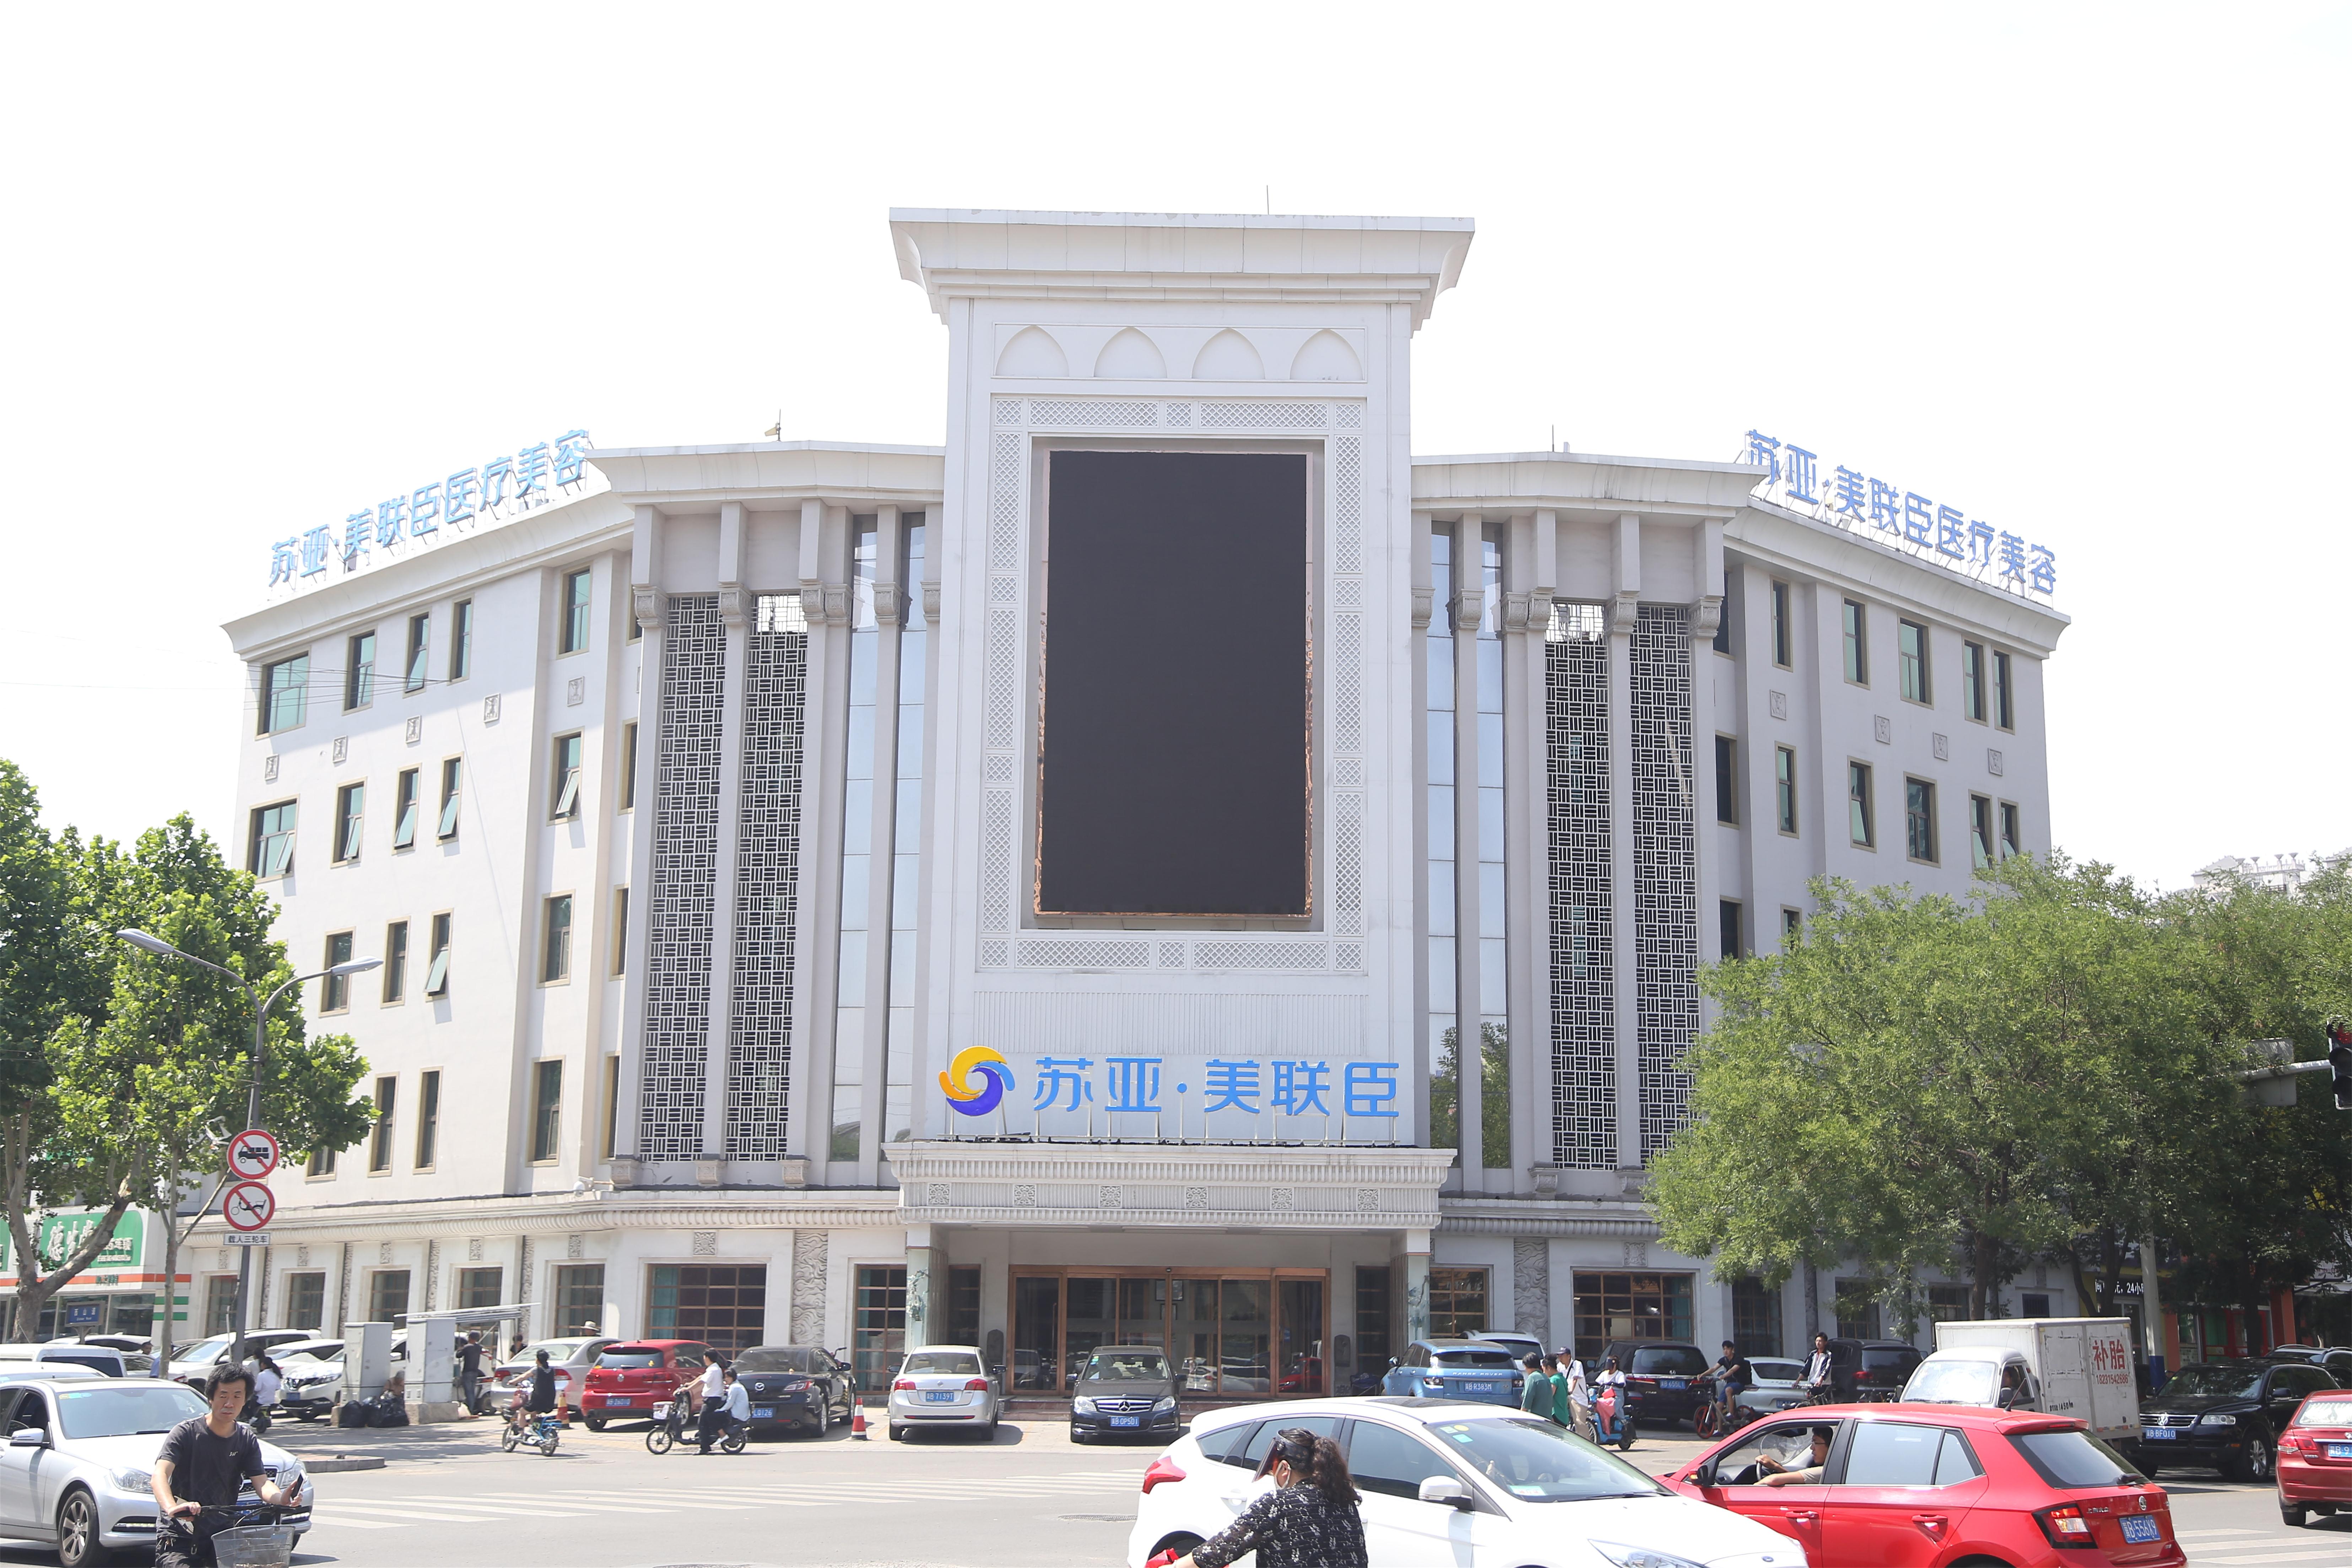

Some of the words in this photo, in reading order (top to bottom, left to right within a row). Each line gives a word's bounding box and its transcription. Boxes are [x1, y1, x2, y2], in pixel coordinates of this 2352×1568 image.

[1034, 1056, 1399, 1117] 苏亚·美联臣
[2092, 1339, 2125, 1370] 补胎
[2097, 1374, 2128, 1384] 18231542686
